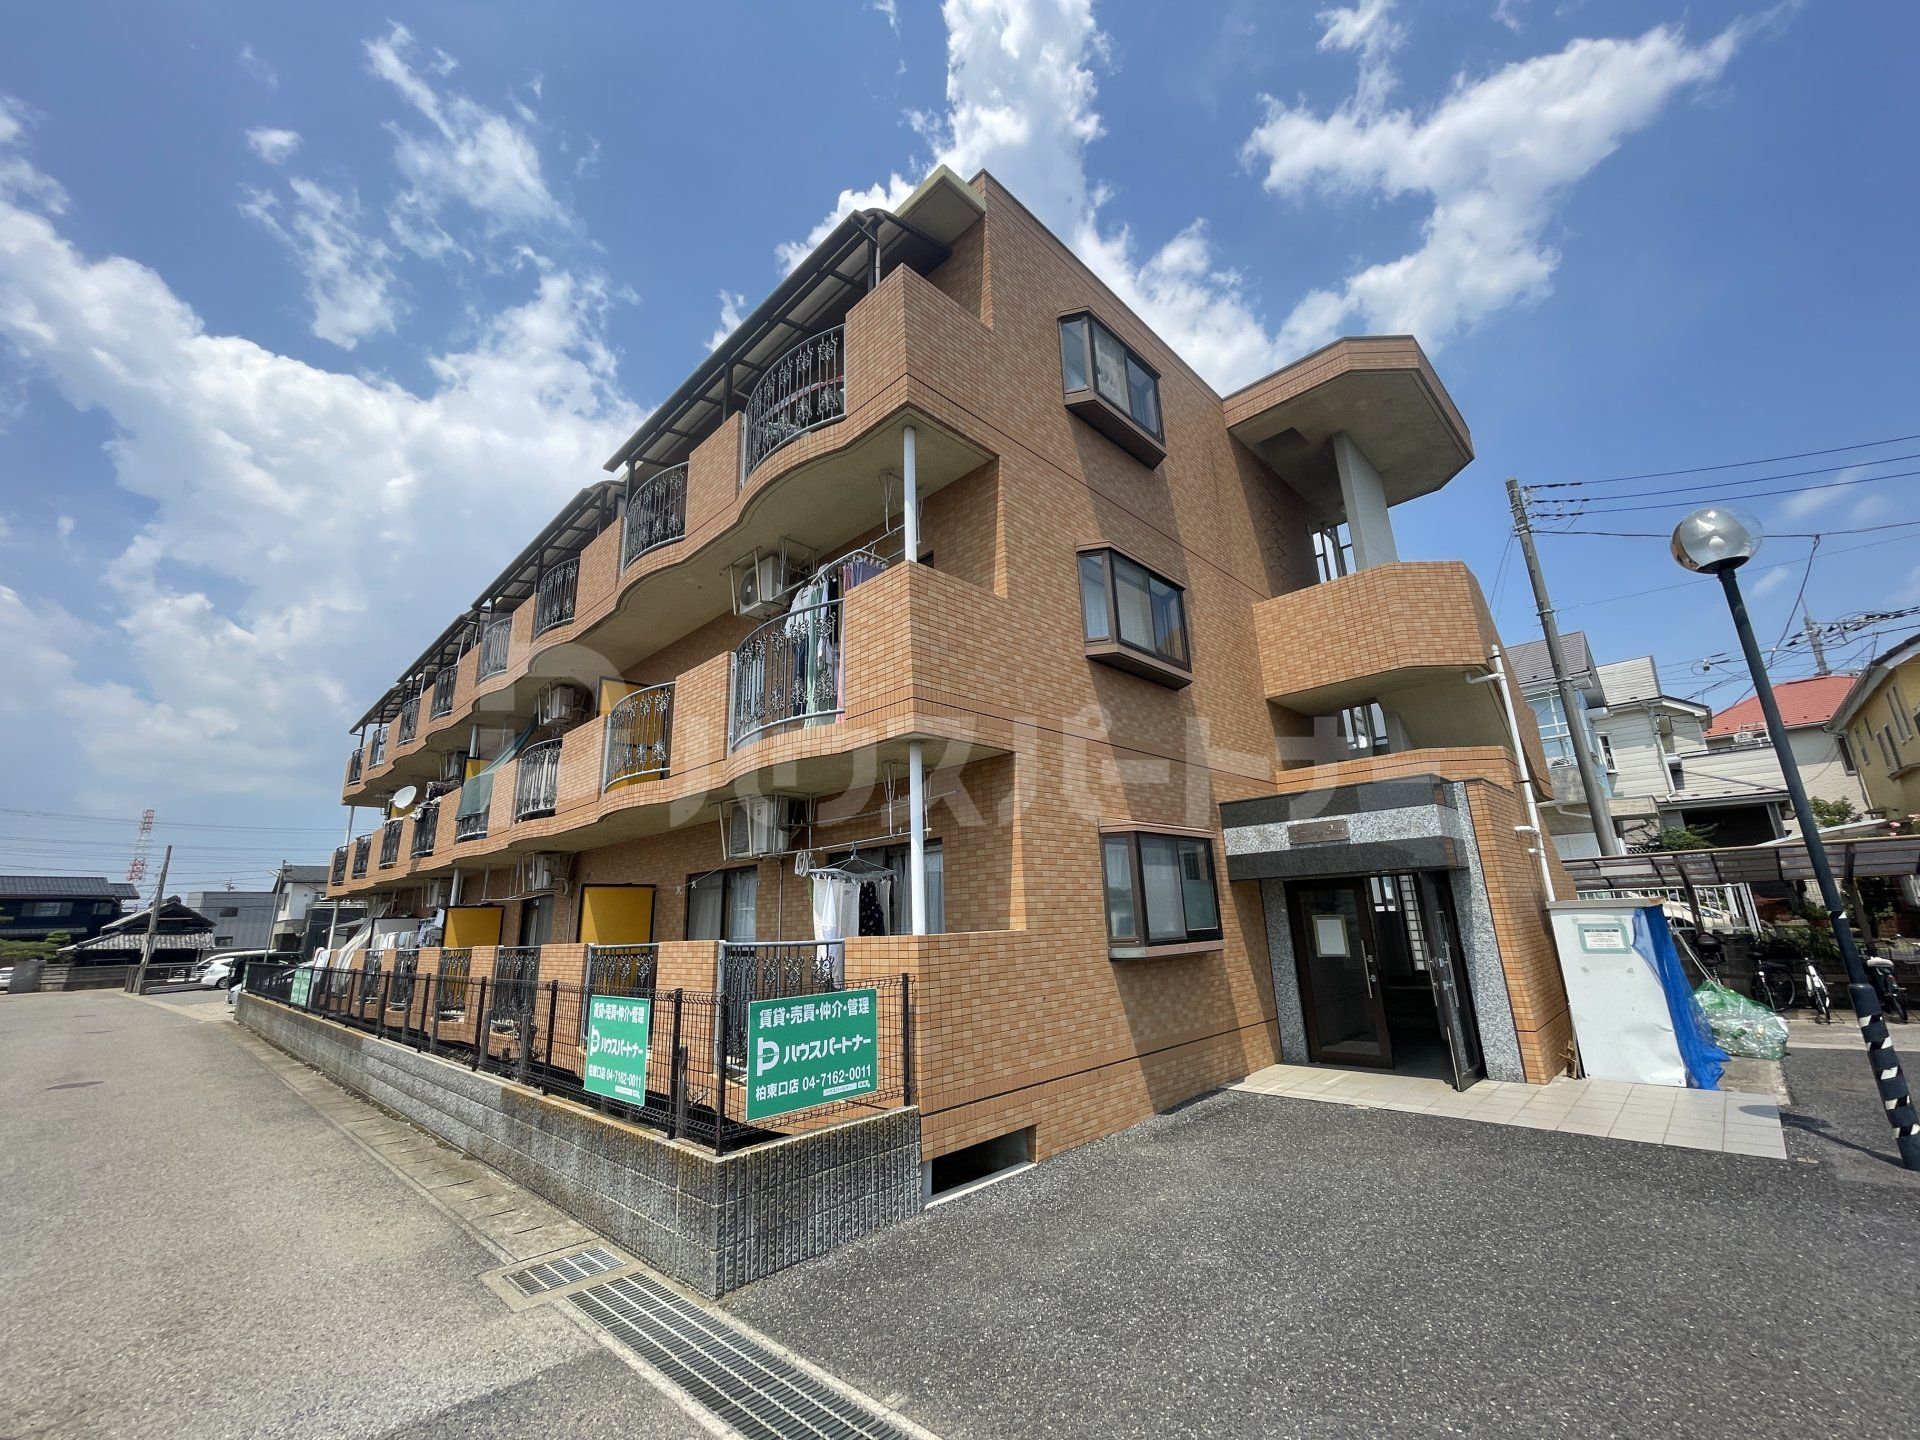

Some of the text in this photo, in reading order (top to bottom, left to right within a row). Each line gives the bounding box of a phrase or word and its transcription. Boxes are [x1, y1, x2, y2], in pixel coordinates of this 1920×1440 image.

[759, 997, 869, 1029] 賃貸・売買・仲介・管理
[600, 1037, 643, 1058] ハウスパートナー
[783, 1034, 871, 1064] ハウスパートナー
[756, 1064, 871, 1101] 柏東口店 04-7162-0011
